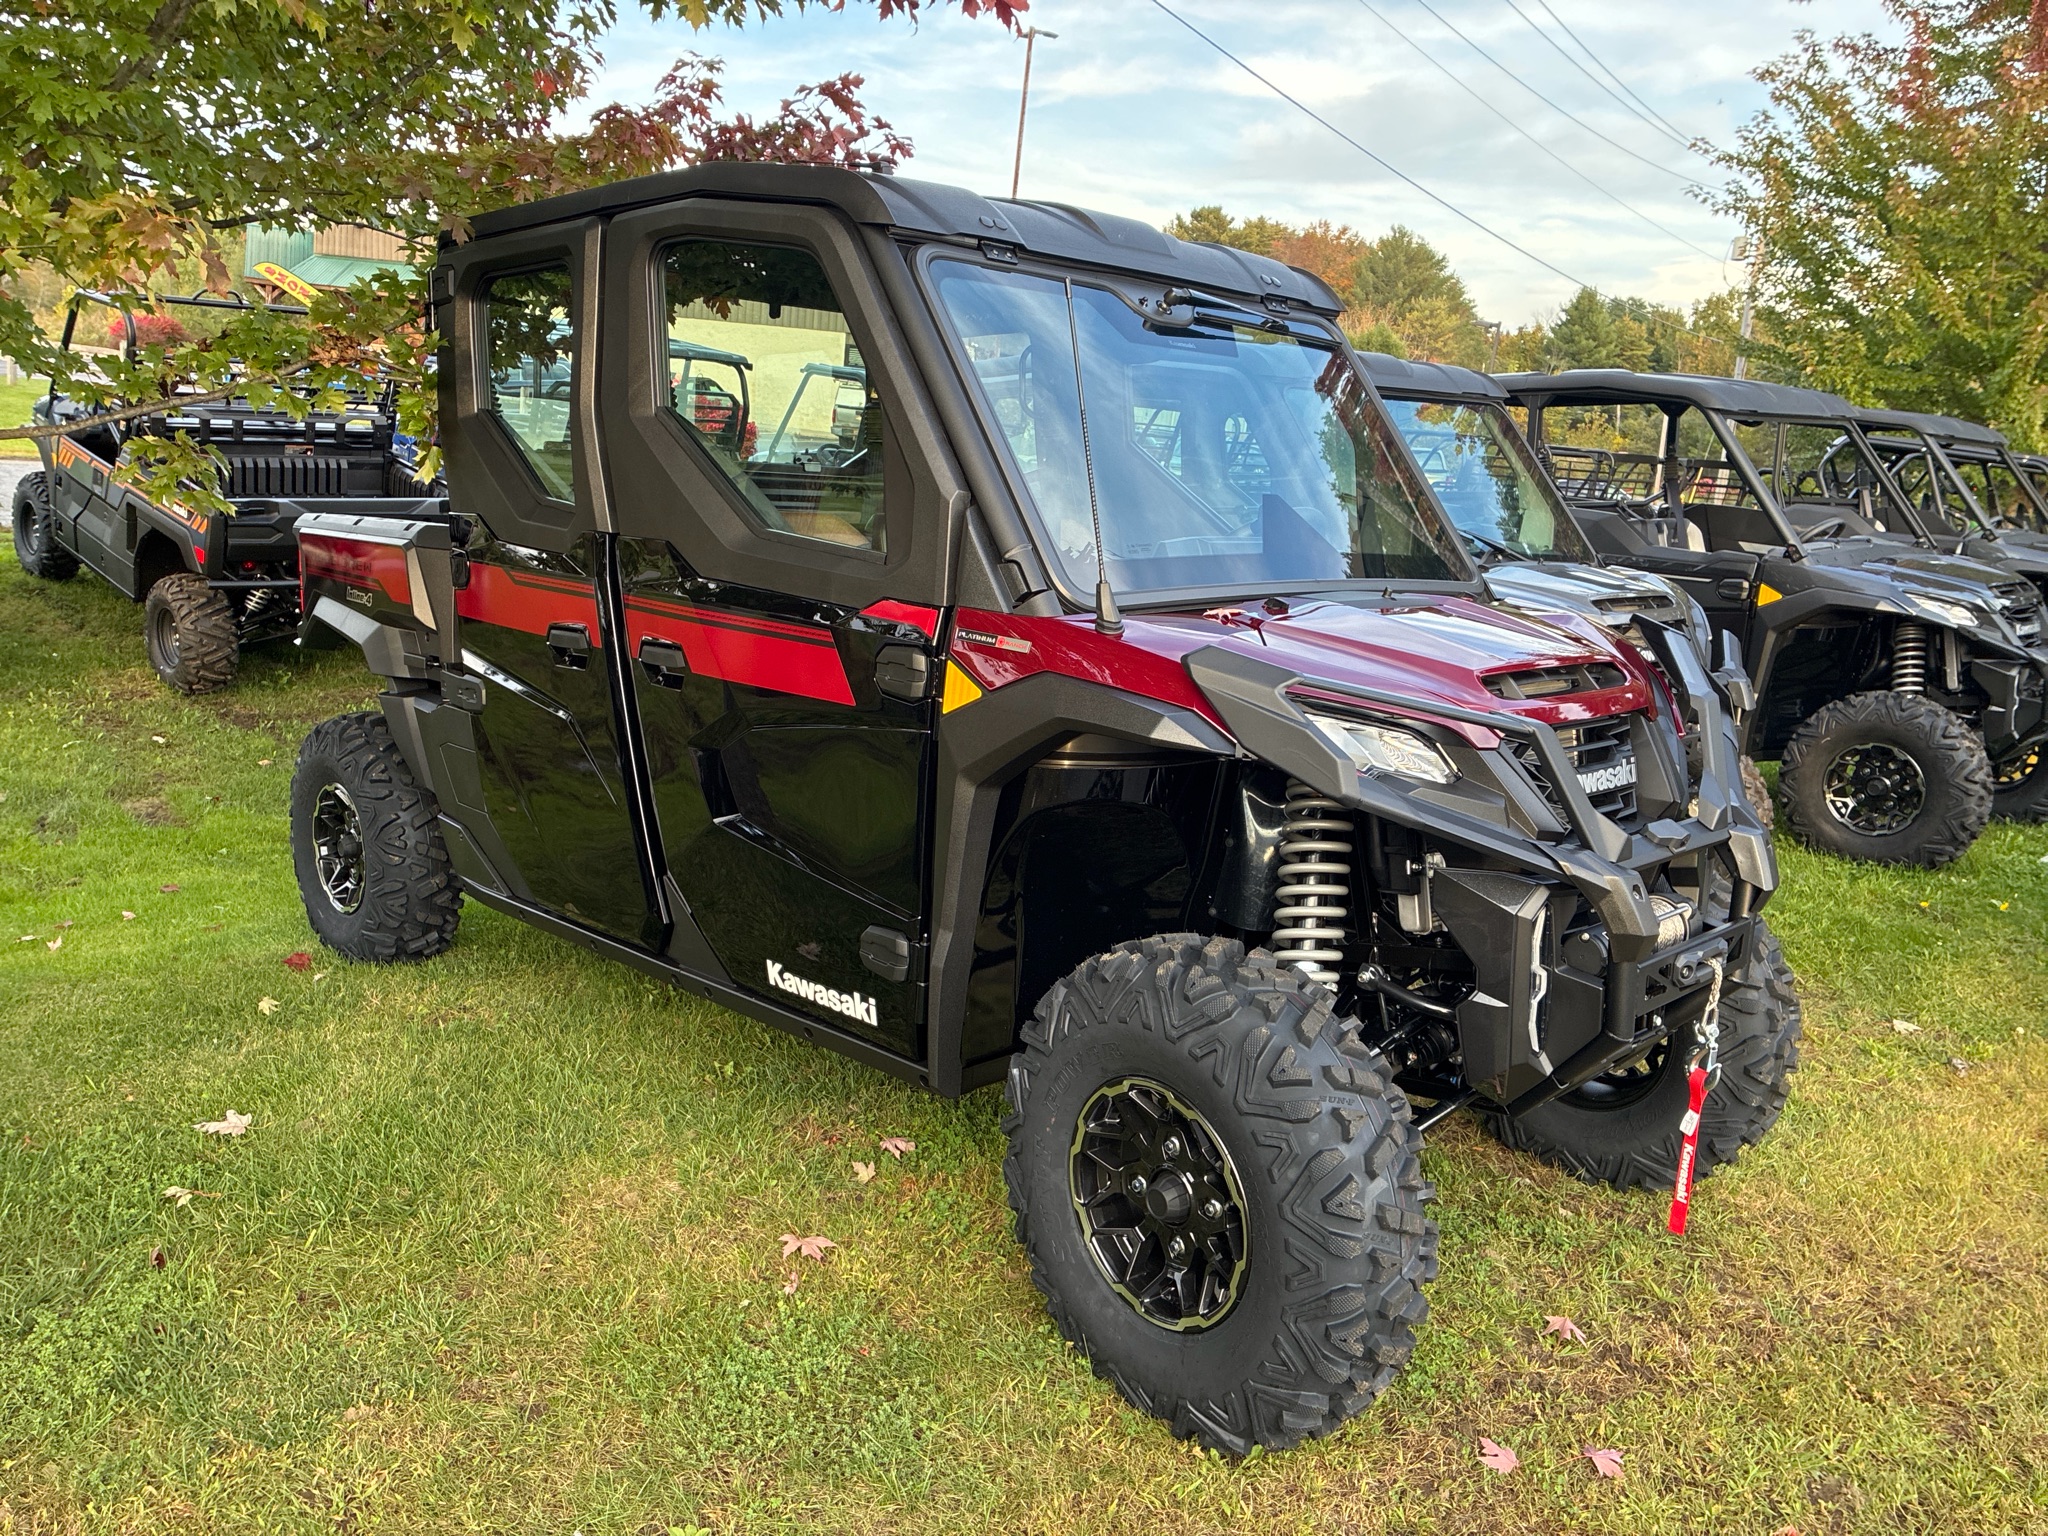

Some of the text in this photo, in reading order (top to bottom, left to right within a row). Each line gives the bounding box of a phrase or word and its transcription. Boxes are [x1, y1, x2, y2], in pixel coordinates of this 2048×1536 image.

[958, 631, 996, 644] PLATINUM
[1576, 757, 1637, 794] wasaki
[766, 959, 878, 1027] Kawasaki
[1676, 1143, 1694, 1204] Kawasaki
